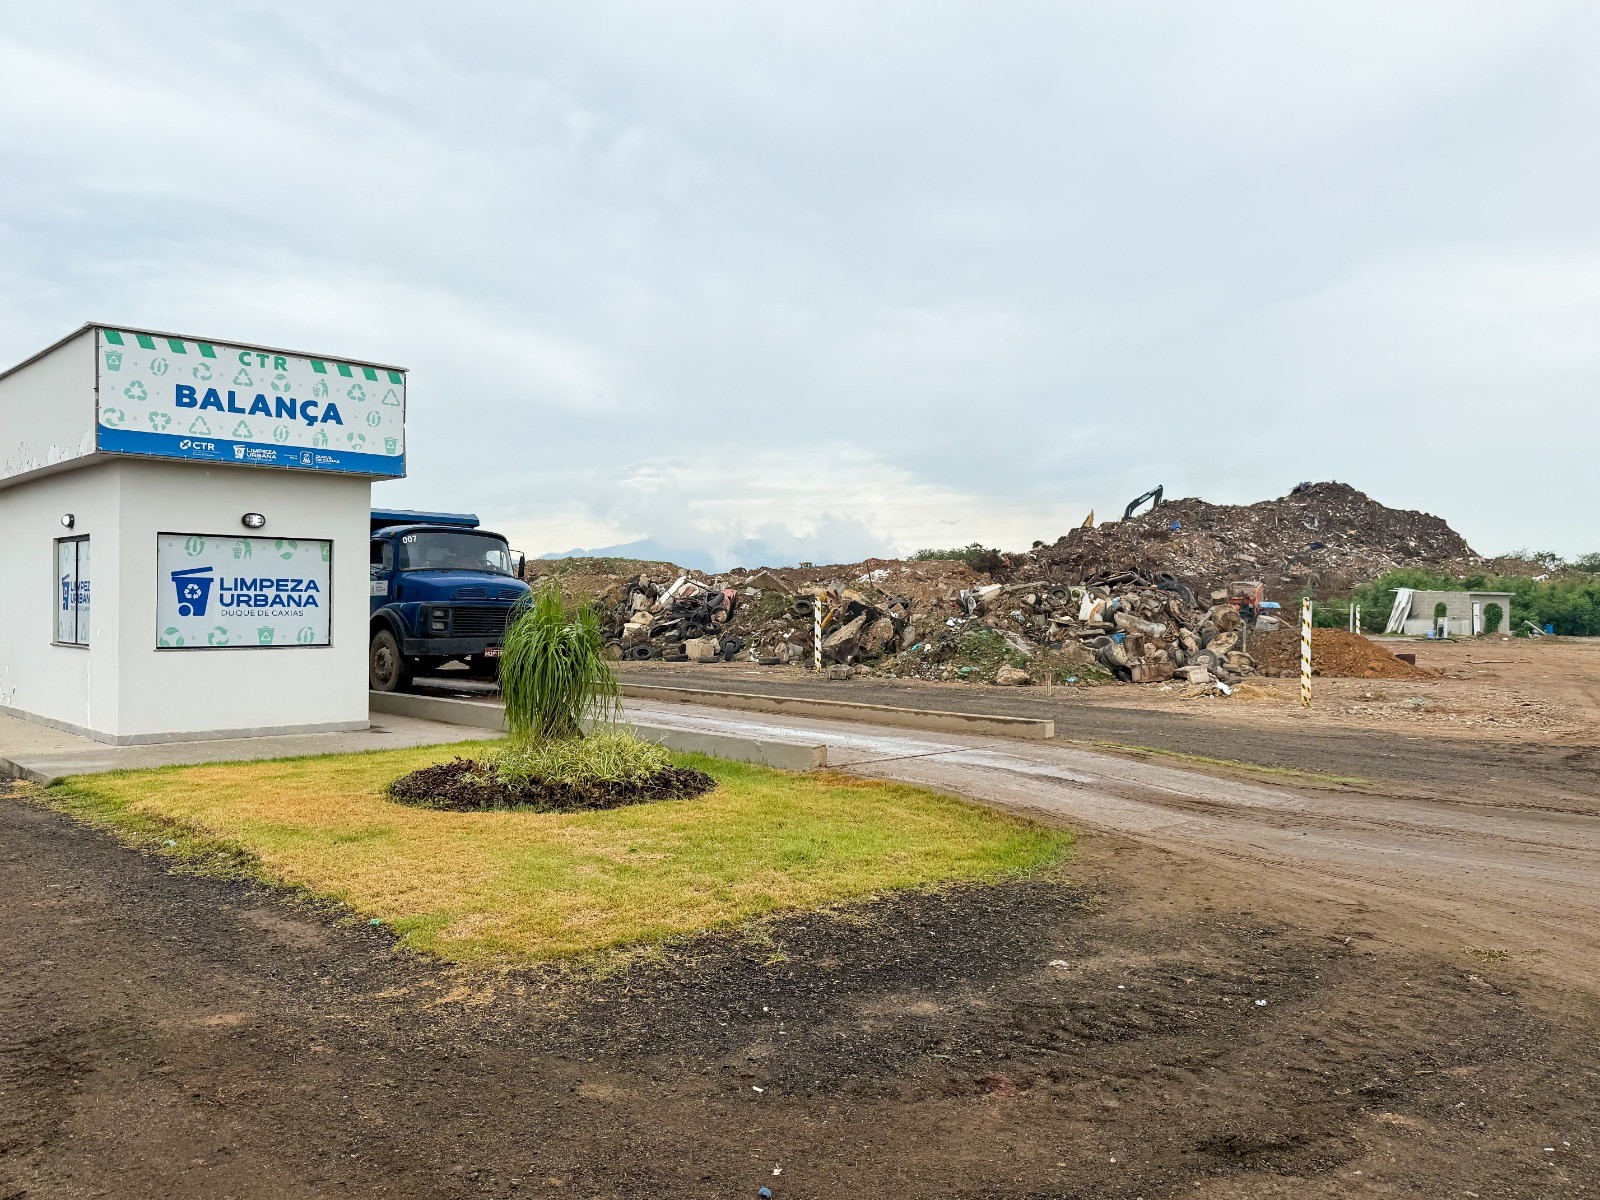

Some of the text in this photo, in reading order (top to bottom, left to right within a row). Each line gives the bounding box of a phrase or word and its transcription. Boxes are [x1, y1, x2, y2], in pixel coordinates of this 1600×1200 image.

[238, 351, 288, 372] CTR
[175, 383, 344, 427] BALANÇA
[192, 441, 215, 451] CTR
[246, 447, 278, 456] LIMPEZA
[246, 452, 277, 460] URBANA
[402, 535, 417, 544] 007
[219, 577, 320, 593] LIMPEZA
[219, 593, 319, 608] URBANA
[221, 609, 304, 618] DUQUE DE CAXIAS
